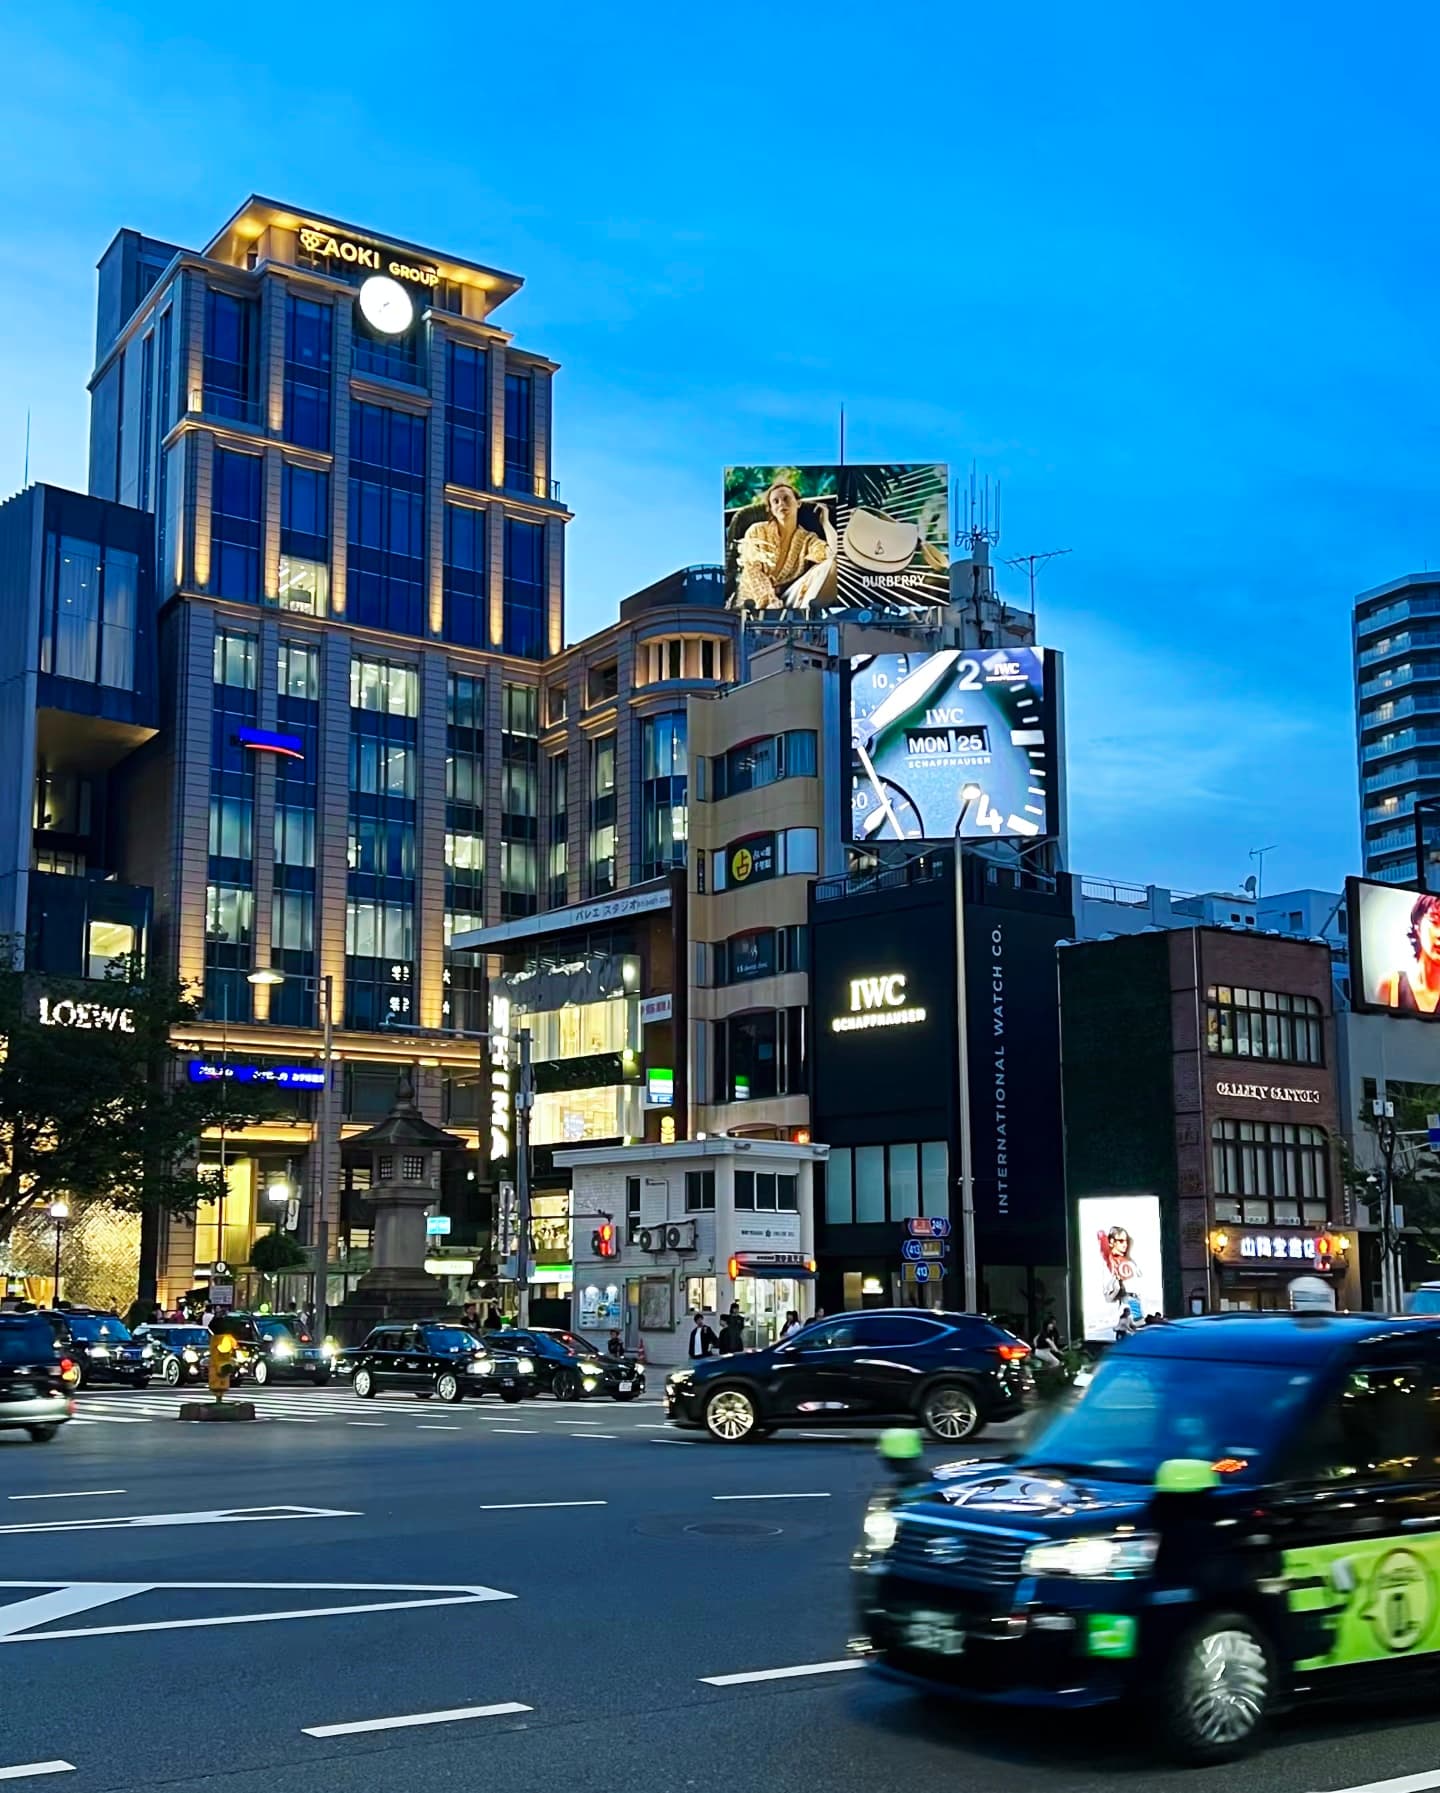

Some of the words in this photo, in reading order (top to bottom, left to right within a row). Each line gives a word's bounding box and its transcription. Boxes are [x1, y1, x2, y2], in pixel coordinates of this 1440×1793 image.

[322, 238, 380, 269] AOKI
[388, 262, 440, 287] GROUP
[862, 574, 925, 588] BURBERRY
[958, 659, 983, 690] 2
[994, 663, 1020, 675] IWC
[926, 708, 964, 724] IWC
[909, 736, 949, 753] MON
[957, 735, 983, 751] 25
[908, 757, 992, 769] SCHAFFHAUSEN
[976, 794, 1003, 833] 4
[991, 924, 1002, 957] CO.
[850, 974, 906, 1011] IWC
[993, 966, 1003, 1036] WATCH
[40, 998, 135, 1033] LOEWE
[995, 1045, 1008, 1214] INTERNATIONAL
[909, 1244, 921, 1253] 413
[916, 1267, 928, 1275] 413
